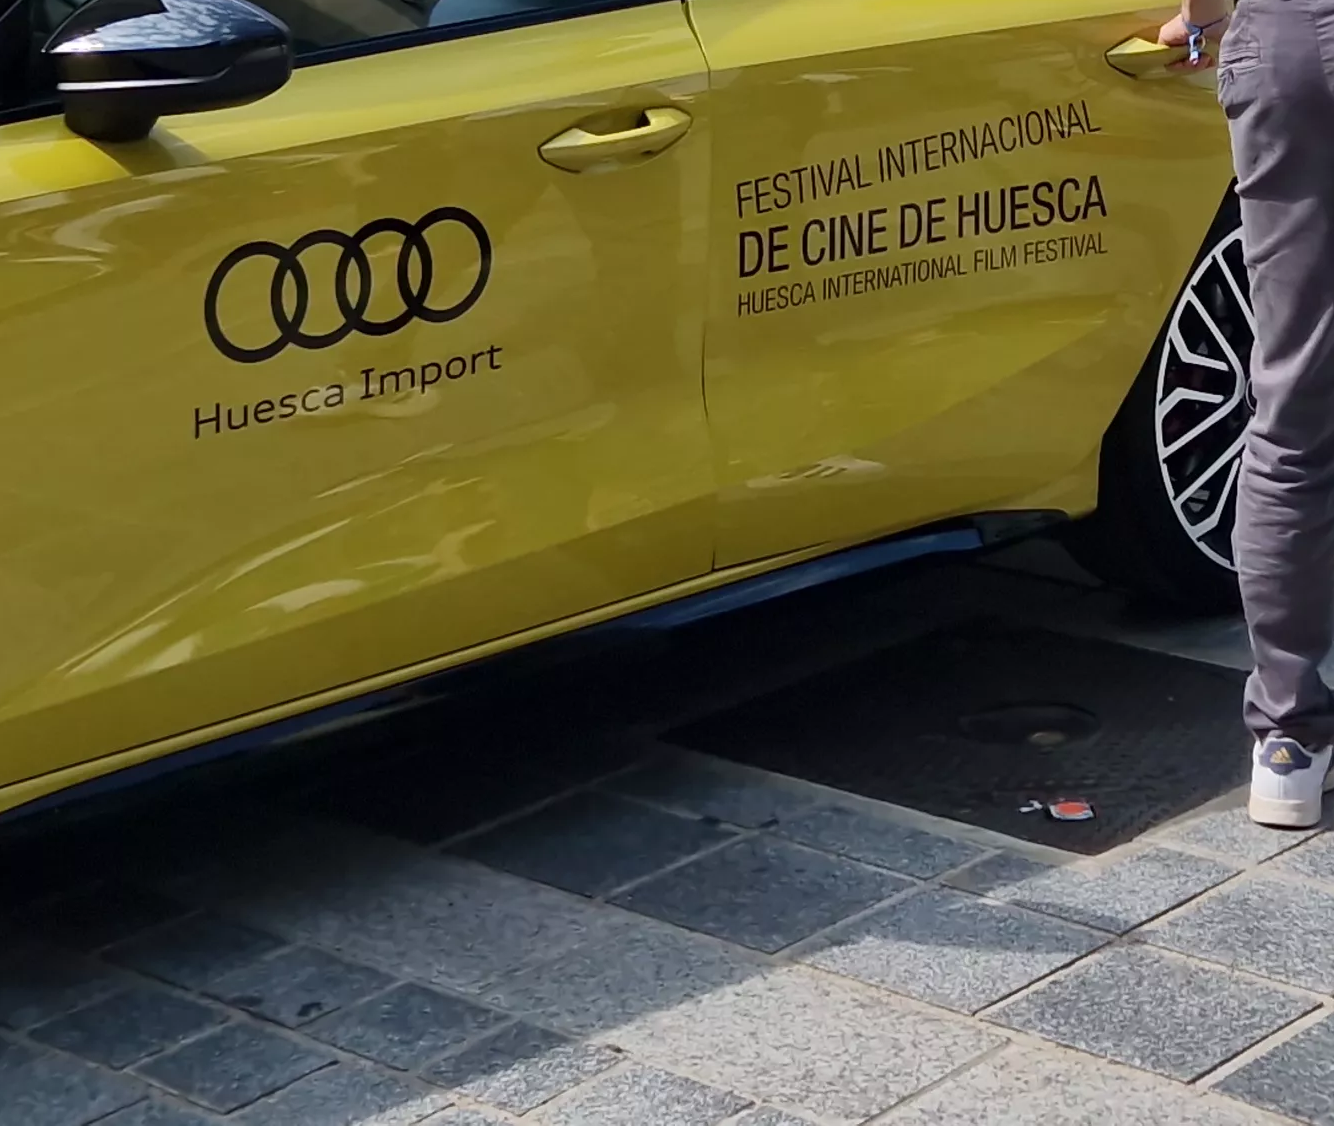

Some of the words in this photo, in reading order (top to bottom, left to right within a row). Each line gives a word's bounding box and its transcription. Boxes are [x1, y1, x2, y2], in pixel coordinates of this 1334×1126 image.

[736, 154, 872, 218] FESTIVAL
[878, 99, 1102, 183] INTERNACIONAL
[737, 282, 816, 317] HUESCA
[822, 253, 968, 301] INTERNATIONAL
[973, 244, 1017, 273] FILM
[1023, 232, 1108, 265] FESTIVAL
[738, 225, 790, 278] DE
[801, 207, 889, 267] CINE
[899, 197, 947, 249] DE
[957, 175, 1108, 238] HUESCA
[194, 384, 345, 439] Huesca
[359, 344, 503, 401] Import
